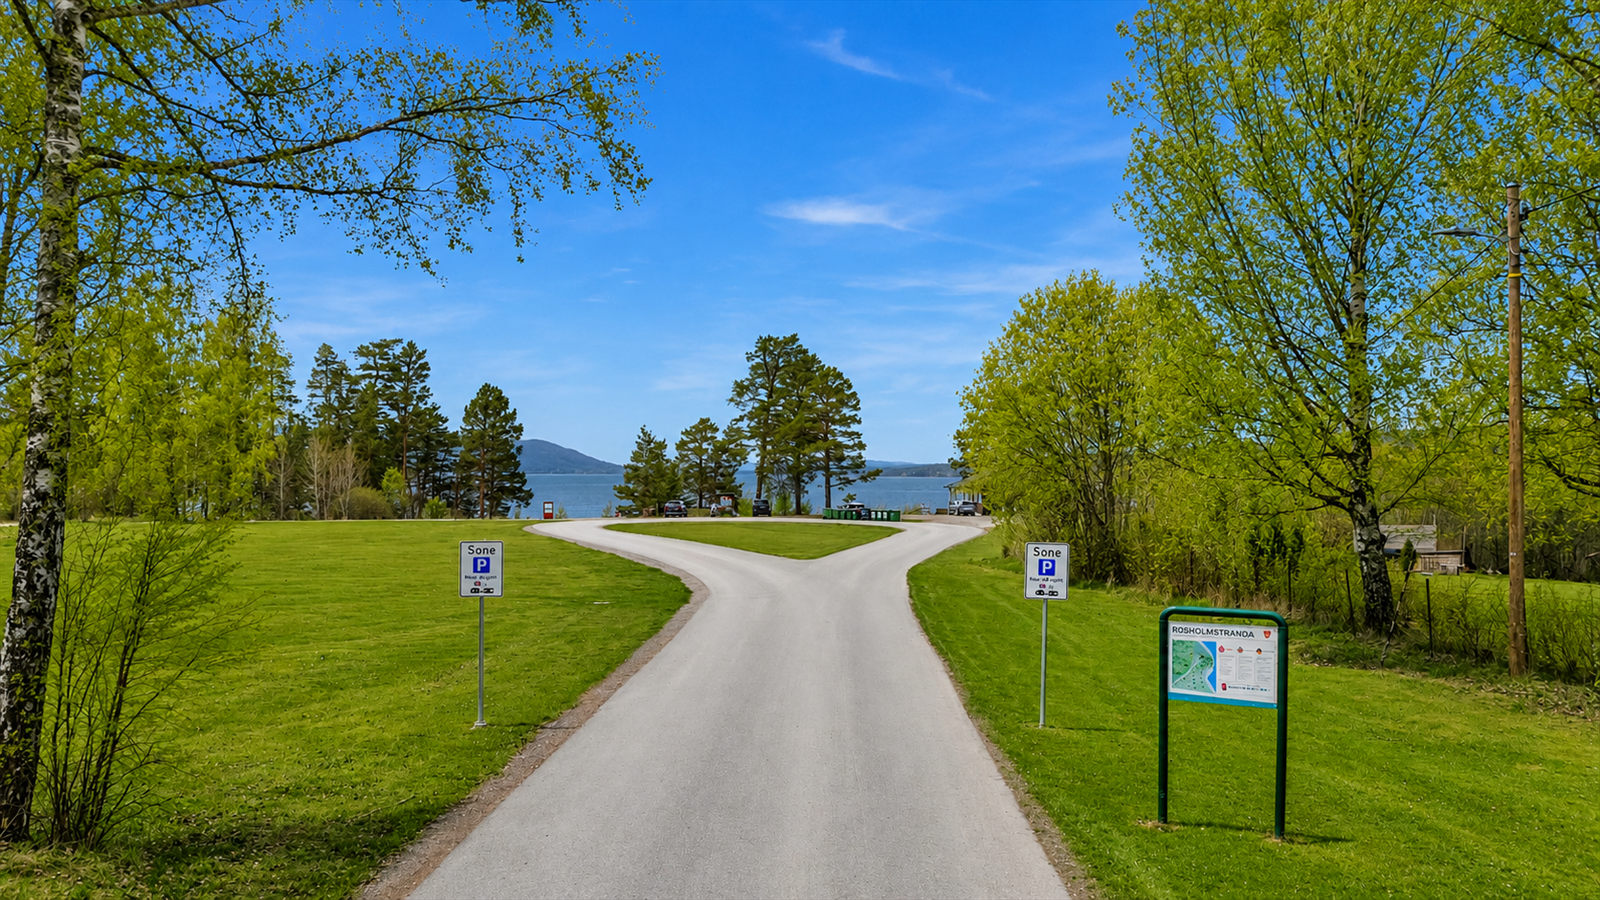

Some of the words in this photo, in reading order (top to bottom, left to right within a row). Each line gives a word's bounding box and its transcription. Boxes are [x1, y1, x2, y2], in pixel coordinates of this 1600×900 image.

[468, 545, 496, 555] Sone
[1033, 547, 1061, 557] Sone
[477, 558, 487, 571] P
[1042, 561, 1053, 574] P
